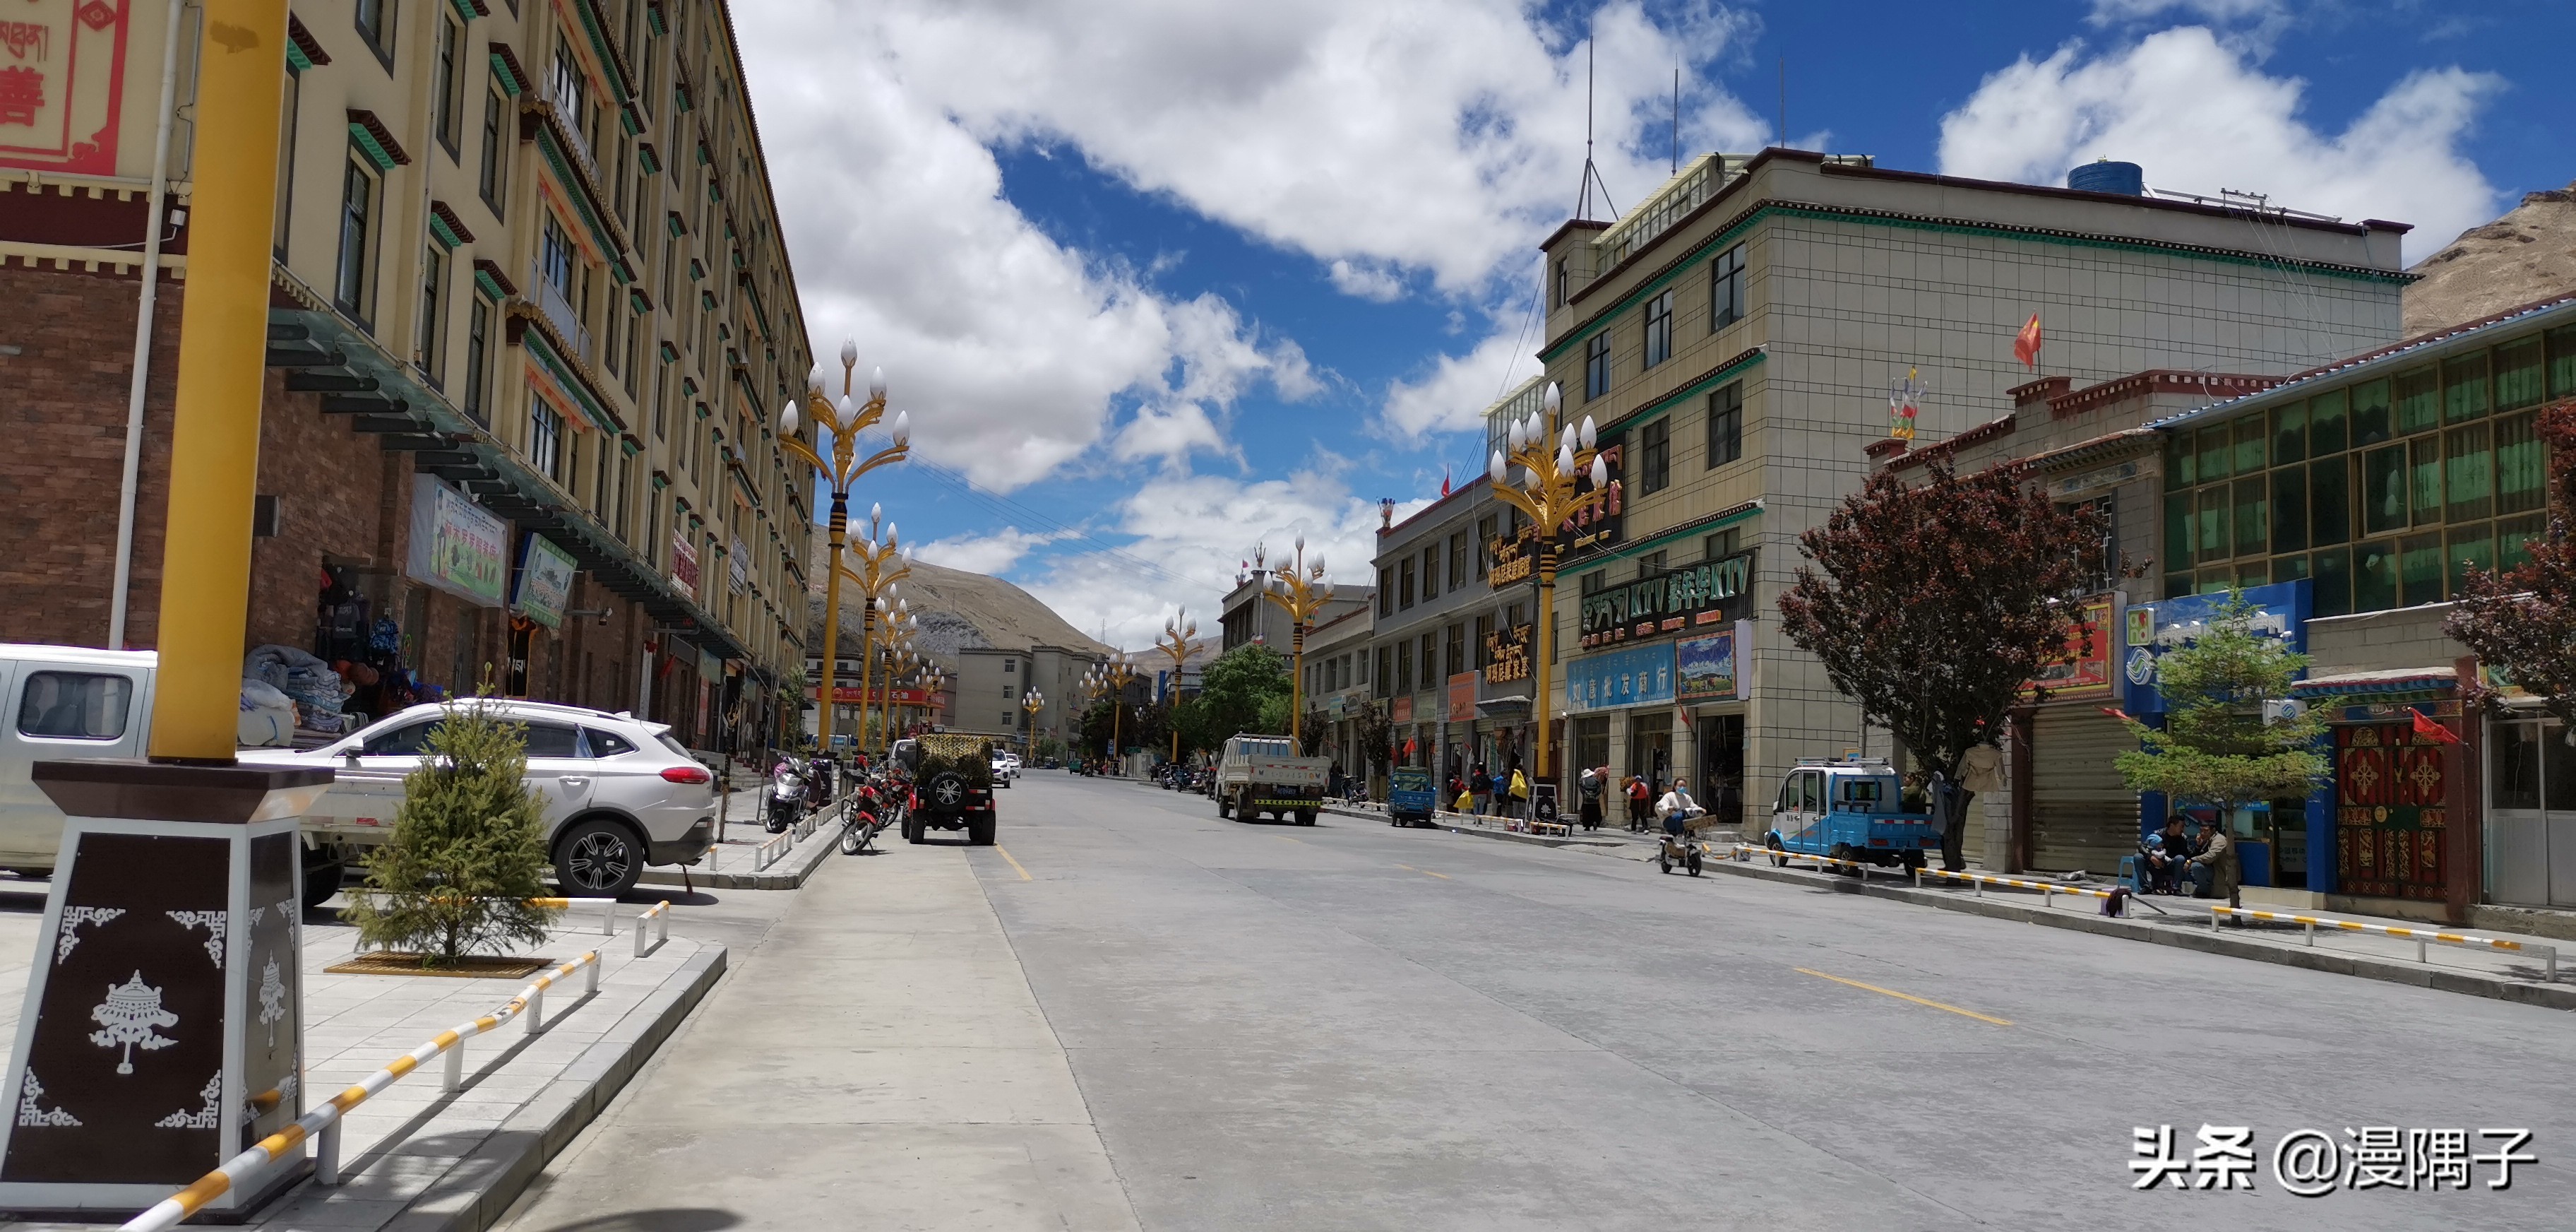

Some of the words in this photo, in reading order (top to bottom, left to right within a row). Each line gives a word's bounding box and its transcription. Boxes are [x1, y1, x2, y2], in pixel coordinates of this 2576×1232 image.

[0, 65, 45, 127] 善
[1630, 578, 1666, 618] KTV
[1573, 666, 1667, 702] 如意批发商行
